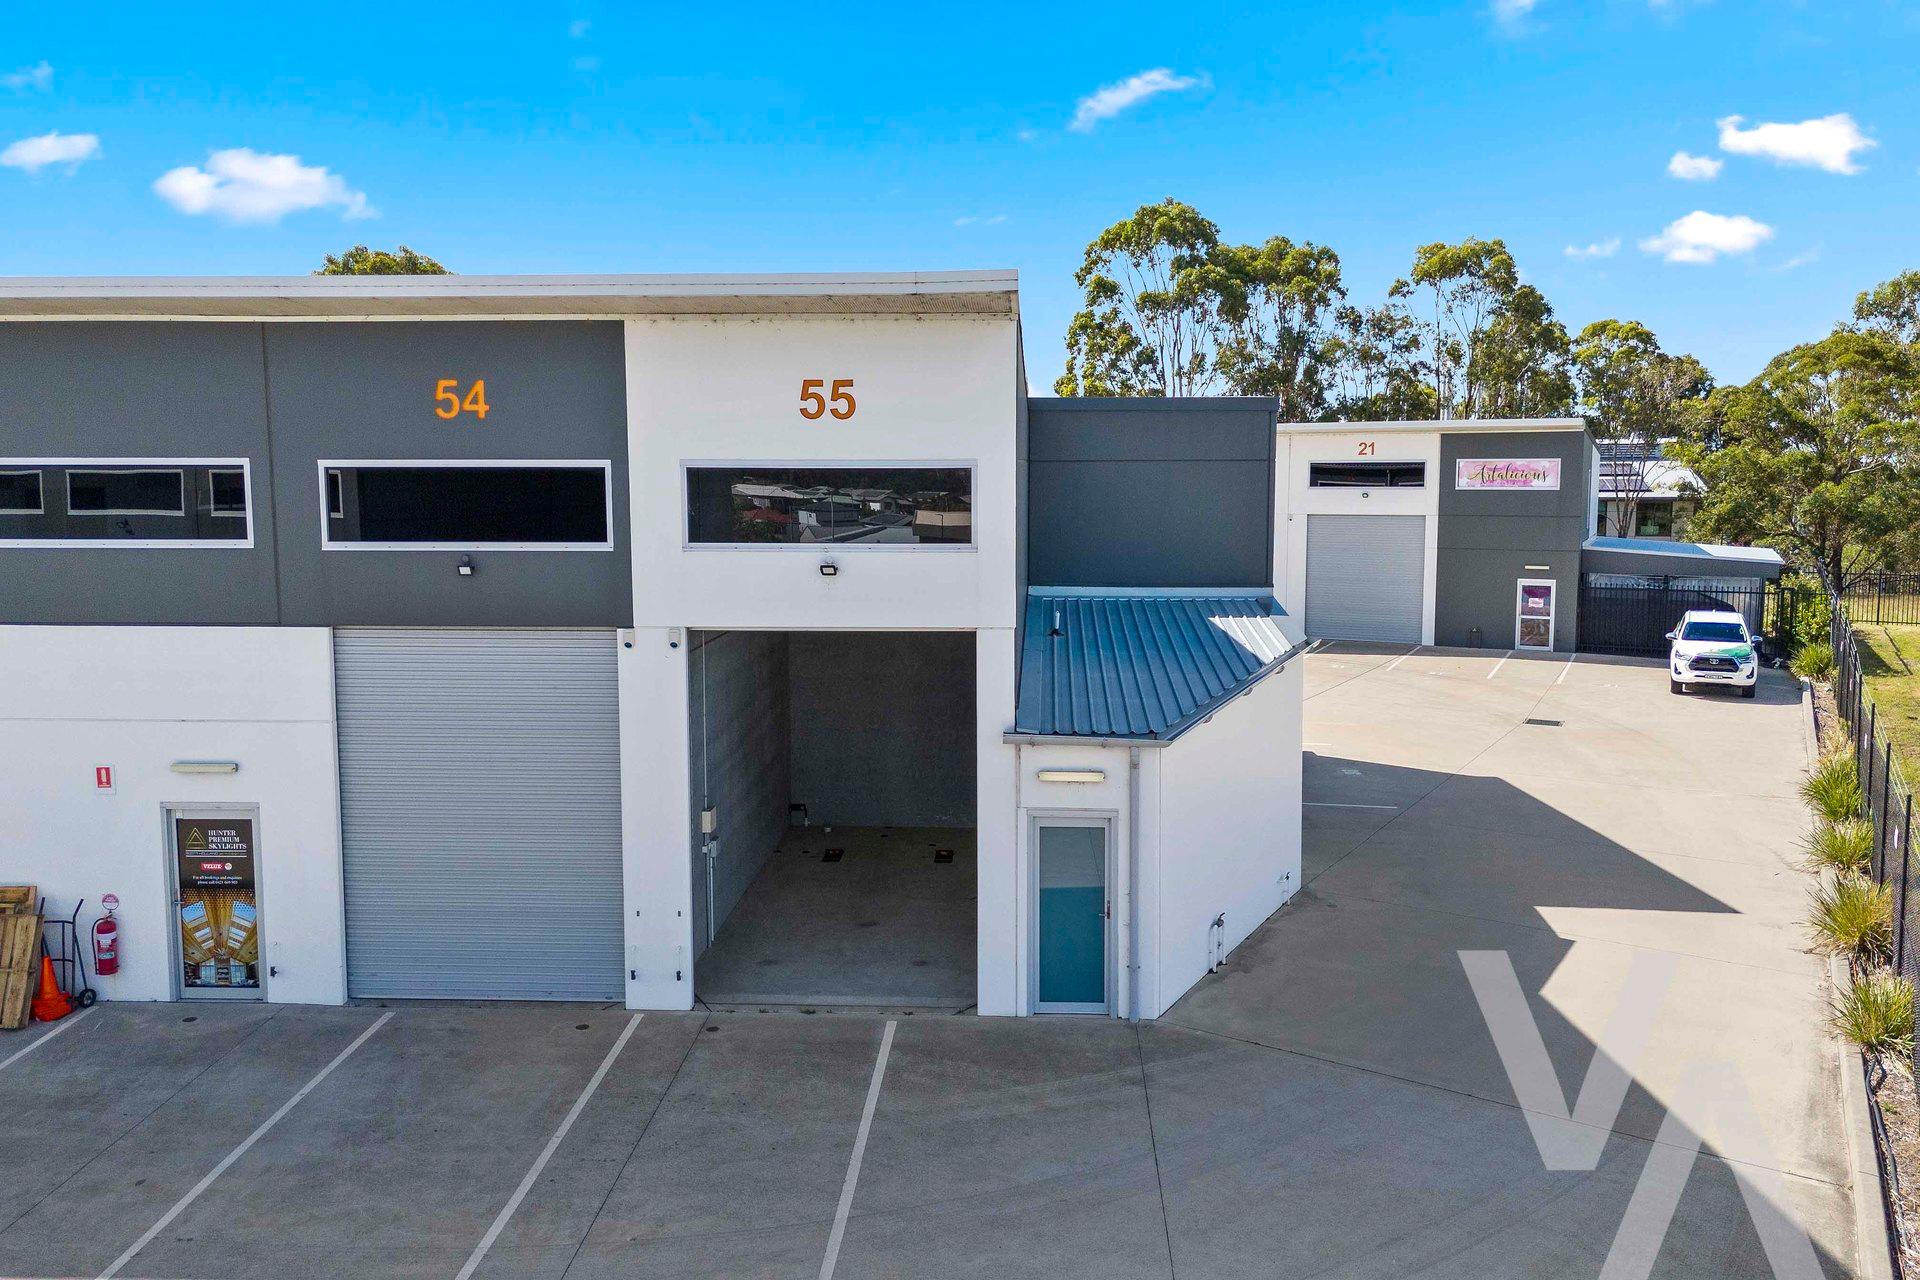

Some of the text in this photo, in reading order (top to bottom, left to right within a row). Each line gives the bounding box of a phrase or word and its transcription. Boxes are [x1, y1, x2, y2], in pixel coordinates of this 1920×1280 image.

[434, 378, 490, 420] 54
[799, 379, 857, 420] 55
[1358, 441, 1376, 456] 21
[1467, 463, 1549, 485] Artalicious
